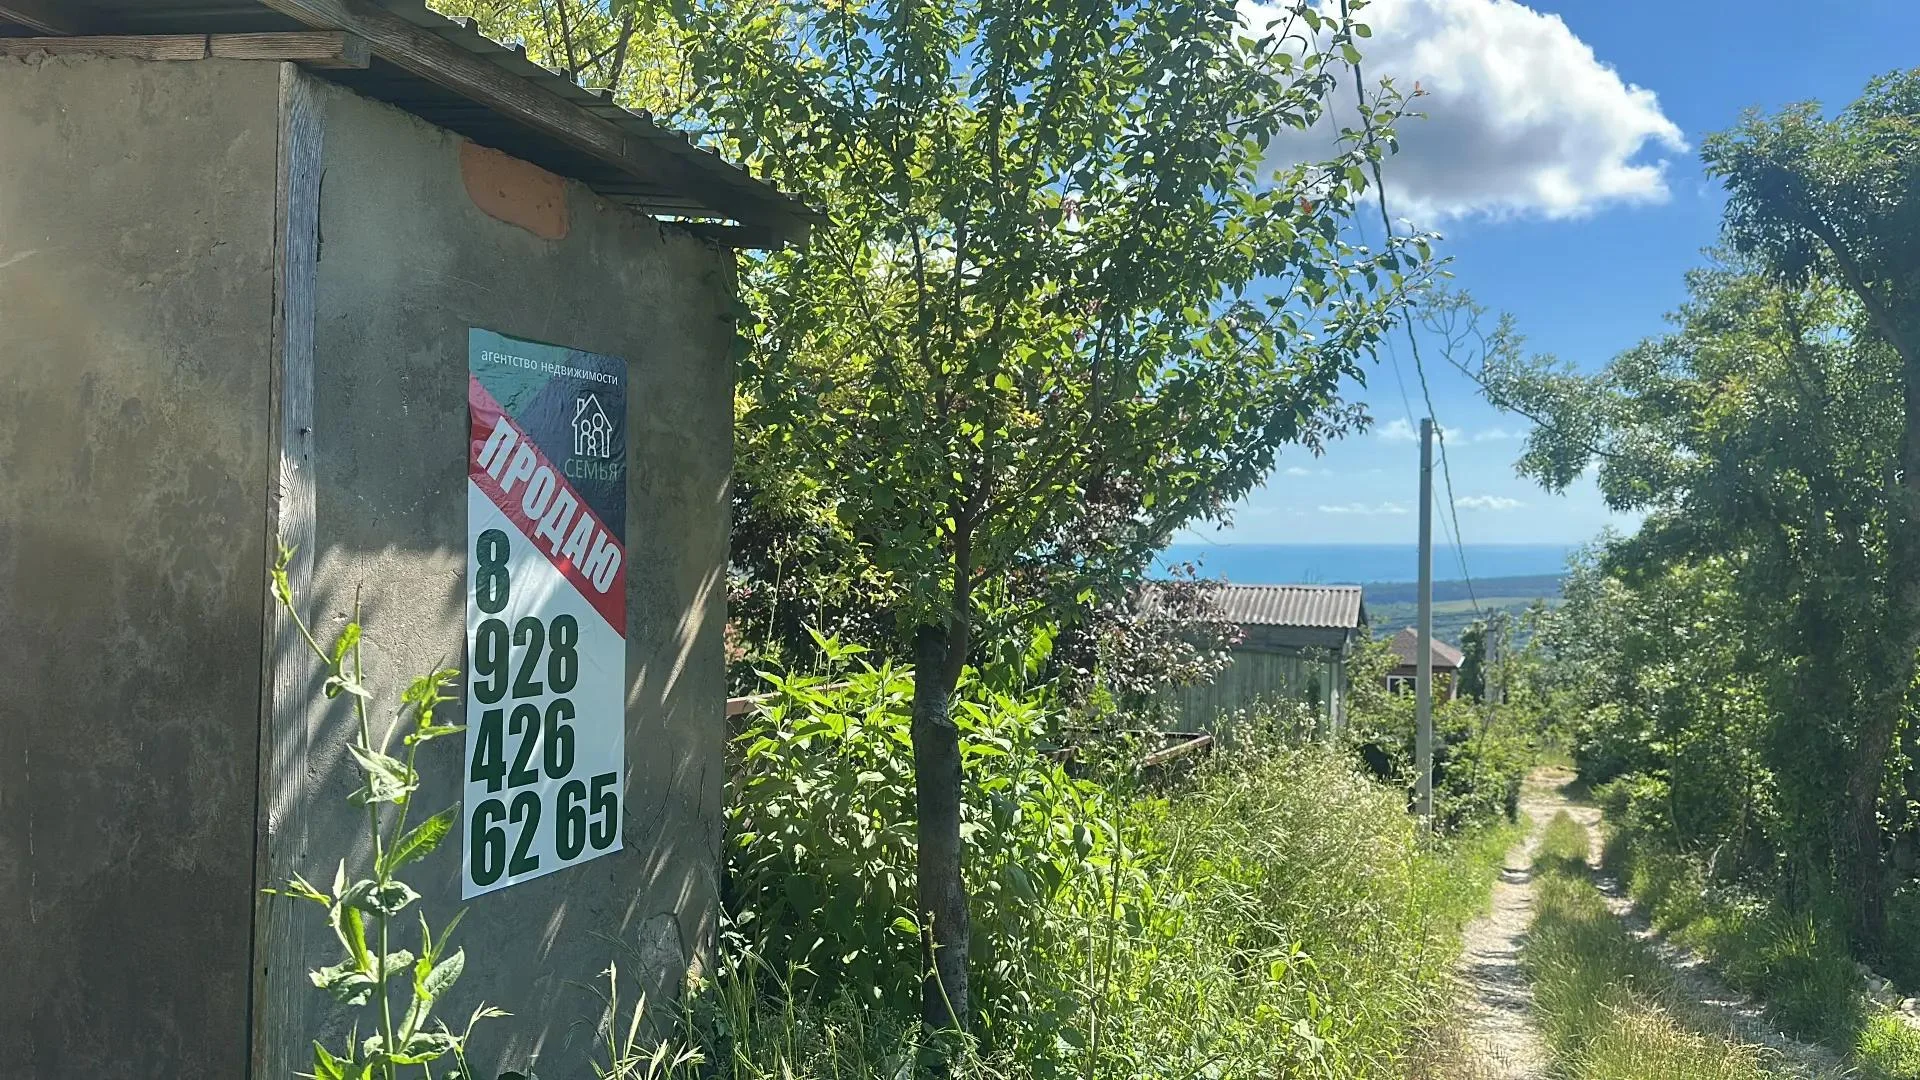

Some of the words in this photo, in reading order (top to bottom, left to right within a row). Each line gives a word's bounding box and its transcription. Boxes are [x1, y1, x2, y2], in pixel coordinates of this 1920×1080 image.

[481, 350, 538, 370] агентство
[541, 361, 618, 385] недвижимости
[477, 415, 622, 594] ПРОДАЮ
[564, 458, 618, 481] СЕМЬЯ
[475, 528, 511, 614] 8
[473, 614, 579, 704] 928
[470, 698, 576, 794] 426
[470, 790, 542, 887] 62
[555, 771, 618, 861] 65
